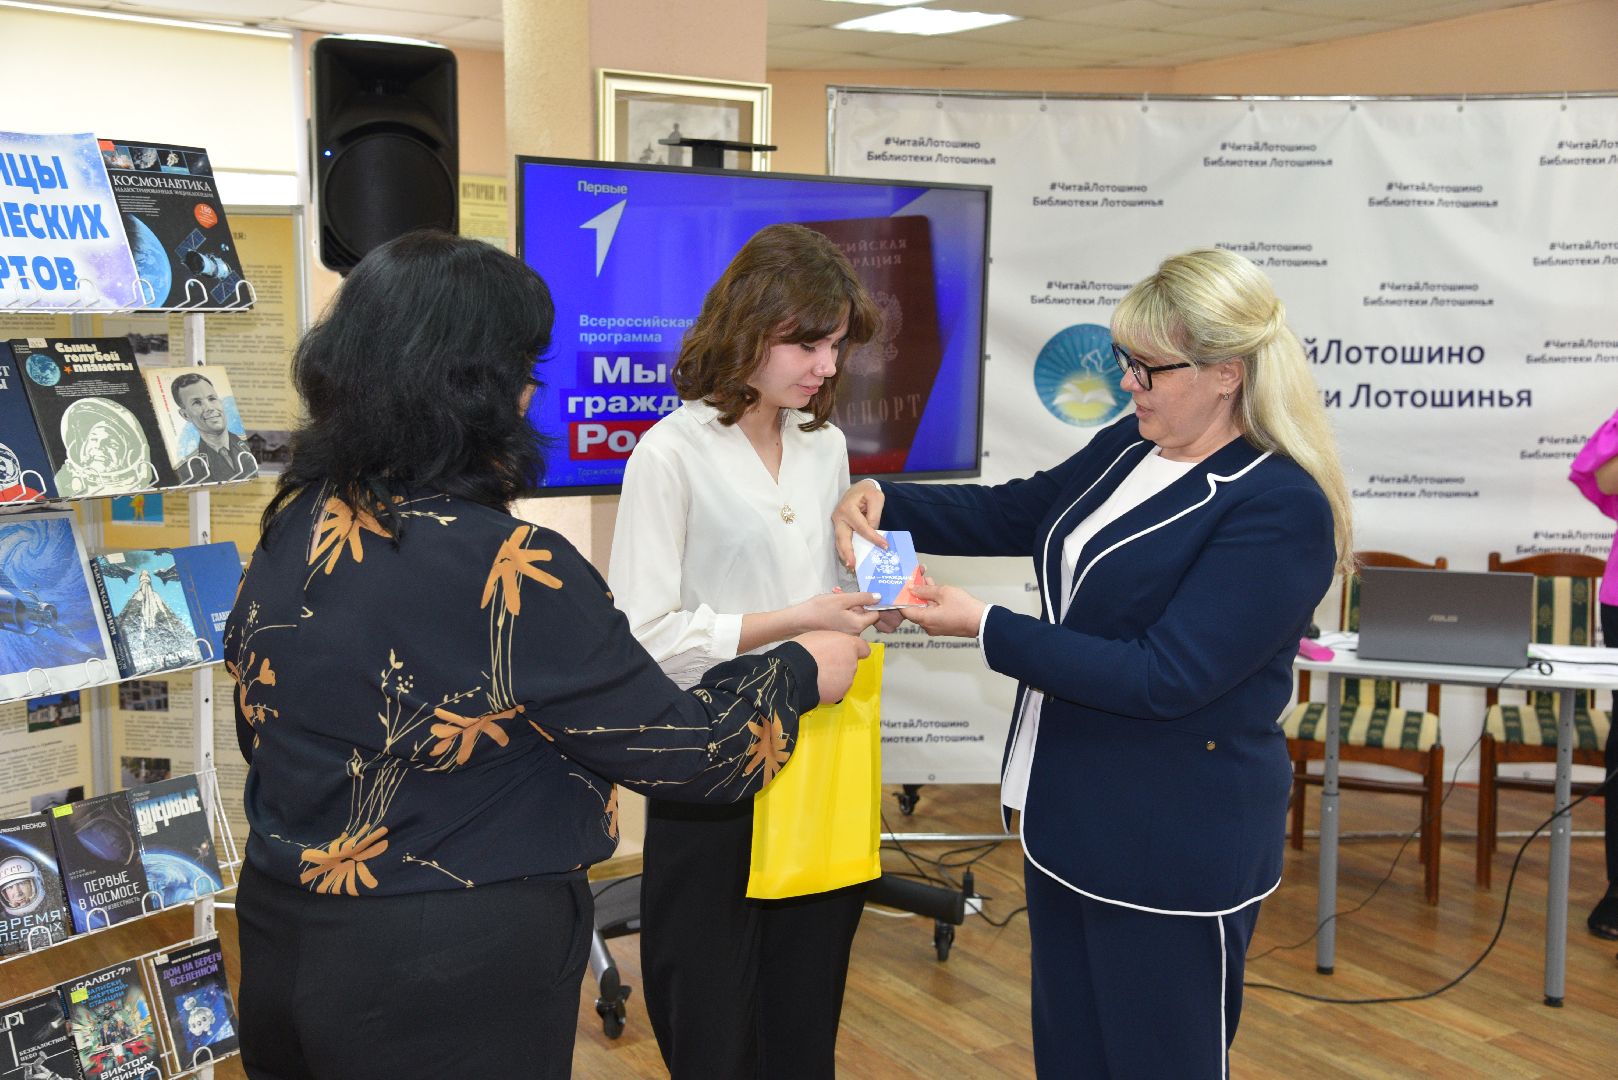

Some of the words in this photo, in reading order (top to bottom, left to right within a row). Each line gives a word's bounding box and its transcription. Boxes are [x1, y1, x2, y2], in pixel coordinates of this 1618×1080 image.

[884, 136, 981, 149] #ЧитайЛотошино
[1220, 141, 1317, 153] #ЧитайЛотошино
[866, 151, 933, 163] Библиотеки
[934, 152, 996, 165] Лотошинья
[1203, 156, 1267, 168] Библиотеки
[1269, 157, 1333, 168] Лотошинья
[1539, 155, 1606, 166] Библиотеки
[112, 174, 212, 193] КОСМОНАВТИКА
[577, 180, 628, 196] Первые
[1049, 182, 1148, 193] #ЧитайЛотошино
[1385, 182, 1483, 193] #ЧитайЛотошино
[1032, 196, 1098, 208] Библиотеки
[1100, 196, 1164, 208] Лотошинья
[1367, 196, 1435, 208] Библиотеки
[1436, 197, 1499, 209] Лотошинья
[1266, 256, 1328, 267] Лотошинья
[1532, 255, 1600, 267] Библиотеки
[1379, 281, 1479, 293] #ЧитайЛотошино
[1030, 294, 1096, 306] Библиотеки
[1362, 296, 1428, 307] Библиотеки
[1430, 296, 1494, 308] Лотошинья
[579, 314, 694, 330] Всероссийская
[579, 331, 662, 345] программа
[54, 342, 97, 353] Сыны
[64, 350, 121, 364] голубой
[1525, 353, 1593, 364] Библиотеки
[73, 362, 134, 373] планеты
[593, 356, 666, 384] Мы
[1348, 383, 1532, 409] Лотошинья
[577, 423, 647, 453] Ро
[1428, 614, 1459, 623] ASUS
[925, 733, 985, 744] Лотошинья
[21, 821, 47, 831] ЛЕОНОВ
[83, 870, 130, 894] ПЕРВЫЕ
[78, 898, 88, 911] В
[89, 881, 141, 908] КОСМОСЕ
[163, 966, 181, 980] ДОМ
[182, 961, 194, 973] НА
[194, 951, 222, 970] БЕРЕГУ
[169, 963, 219, 987] ВСЕЛЕННОЙ
[100, 1055, 148, 1080] ВИКТОР
